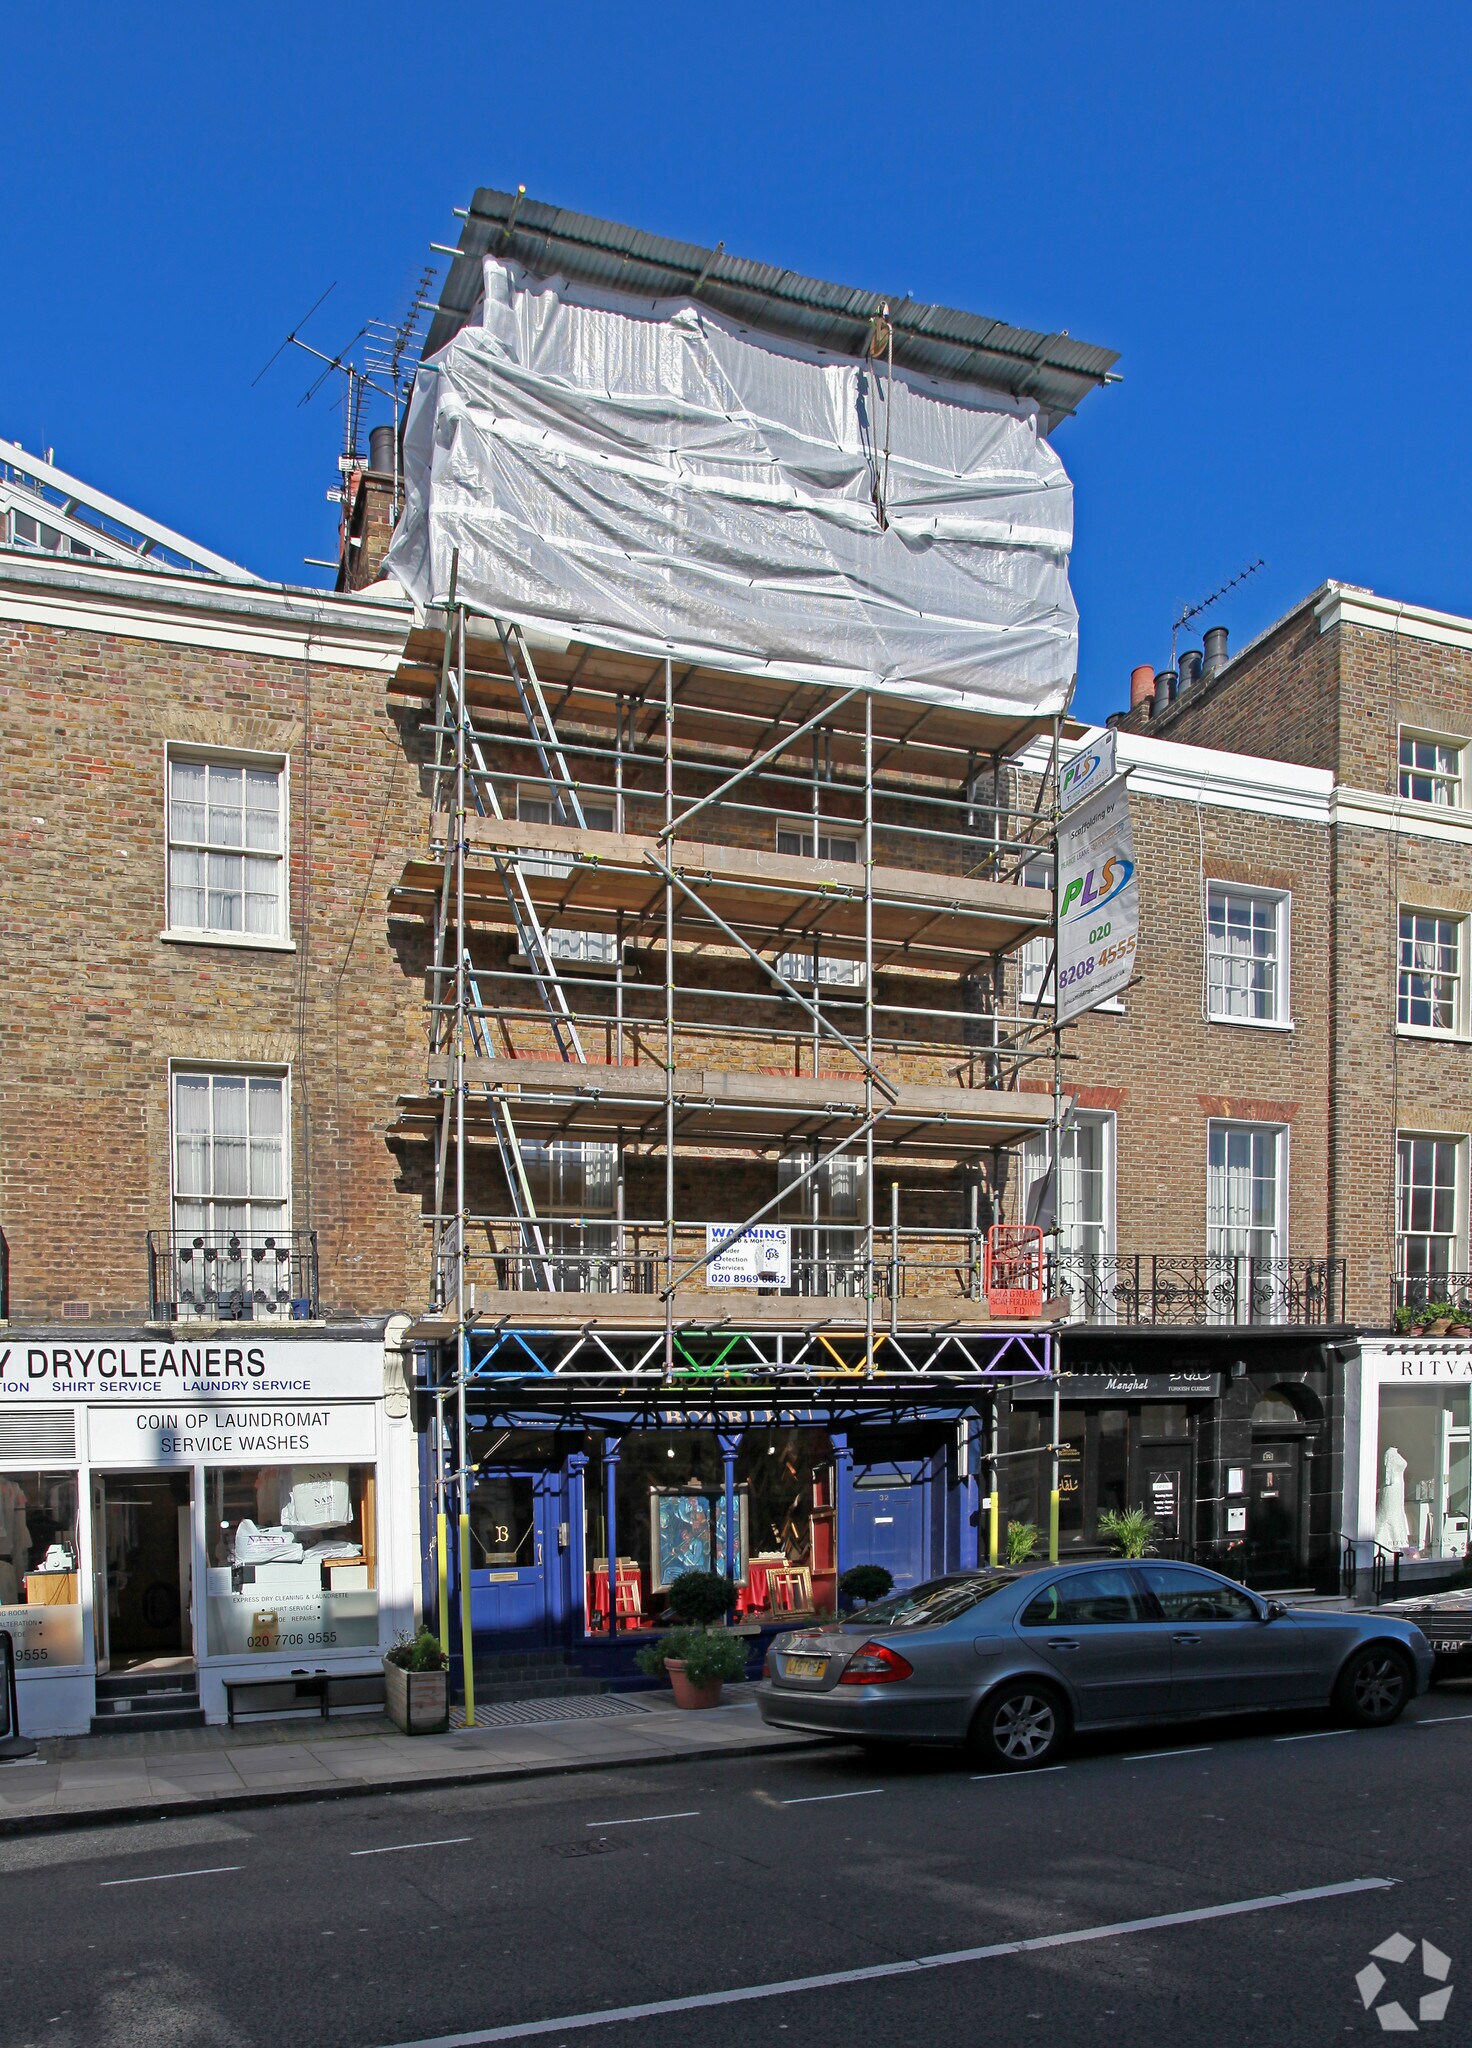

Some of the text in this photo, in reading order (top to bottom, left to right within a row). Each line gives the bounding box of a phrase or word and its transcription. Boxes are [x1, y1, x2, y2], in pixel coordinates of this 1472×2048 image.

[1063, 755, 1092, 792] PLS
[1071, 803, 1115, 840] Scaffolding by
[1060, 855, 1117, 917] PLS
[1089, 922, 1112, 944] 020
[1059, 934, 1137, 989] 8208 4555
[714, 1255, 748, 1263] Detection
[714, 1263, 745, 1271] Services
[711, 1274, 731, 1283] 020
[734, 1274, 759, 1283] 8969
[991, 1298, 1041, 1306] SCAFFOLDING
[995, 1290, 1035, 1298] MAGNER
[1006, 1307, 1026, 1315] LTD
[27, 1348, 266, 1379] DRYCLEANERS
[51, 1381, 96, 1392] SHIRT
[99, 1381, 162, 1392] SERVICE
[183, 1380, 249, 1391] LAUNDRY
[252, 1380, 312, 1390] SERVICE
[1105, 1378, 1149, 1393] Manghal
[136, 1412, 331, 1429] COIN OP LAUNDROMAT
[161, 1435, 309, 1452] SERVICE WASHES
[495, 1525, 510, 1542] B
[247, 1631, 337, 1648] 020 7706 9555
[15, 1648, 48, 1661] 9555
